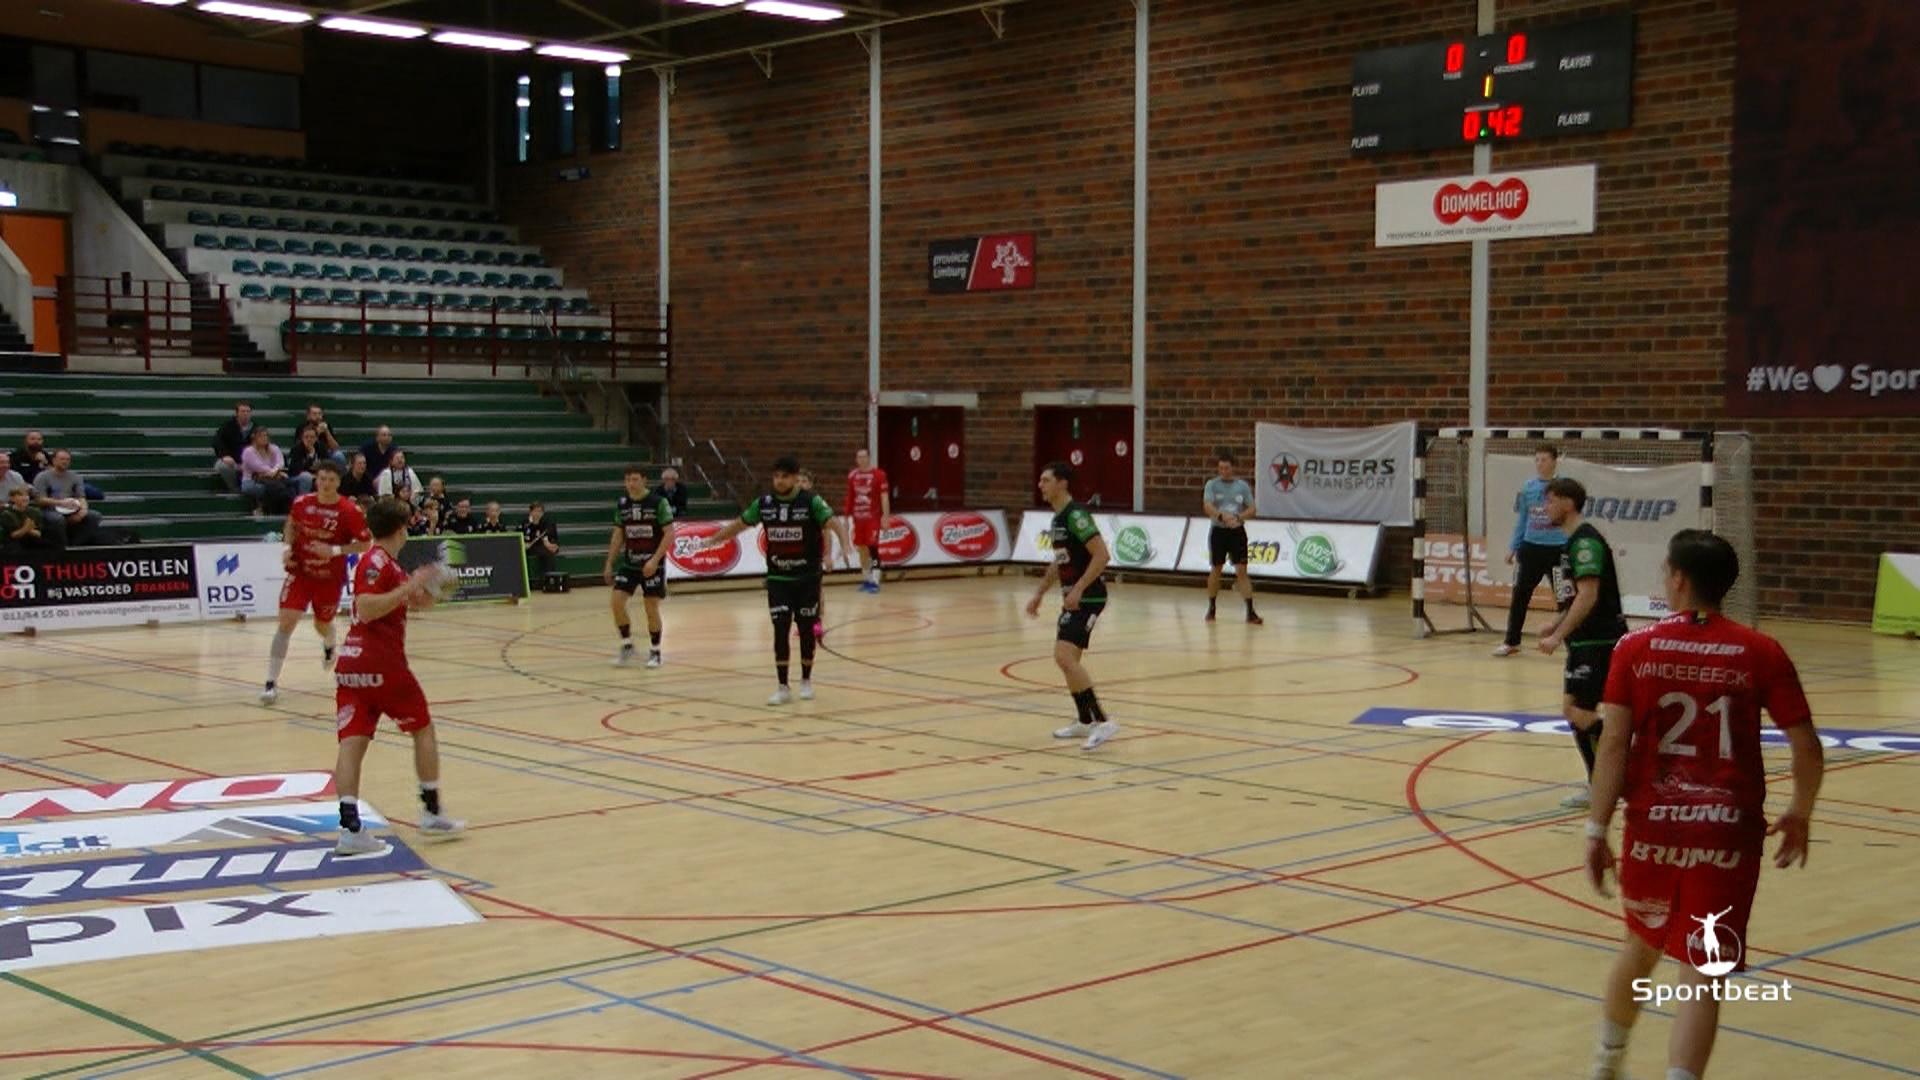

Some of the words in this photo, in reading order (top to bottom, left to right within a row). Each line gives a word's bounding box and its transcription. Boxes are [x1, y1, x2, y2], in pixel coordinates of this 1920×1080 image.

[1507, 32, 1527, 65] 0
[1446, 43, 1465, 74] 0
[1559, 54, 1592, 71] PLAYER
[1352, 83, 1380, 97] PLAYER
[1557, 111, 1591, 127] PLAYER
[1441, 189, 1522, 214] DOMMELHOF
[1746, 366, 1809, 392] #We
[1304, 458, 1396, 476] ALDERS
[1305, 475, 1396, 491] TRANSPORT
[64, 584, 132, 597] VASTGOED
[134, 582, 189, 593] FRANSEN
[207, 584, 255, 603] RDS
[1632, 662, 1749, 685] VANDEBEECK
[1657, 691, 1734, 760] 21
